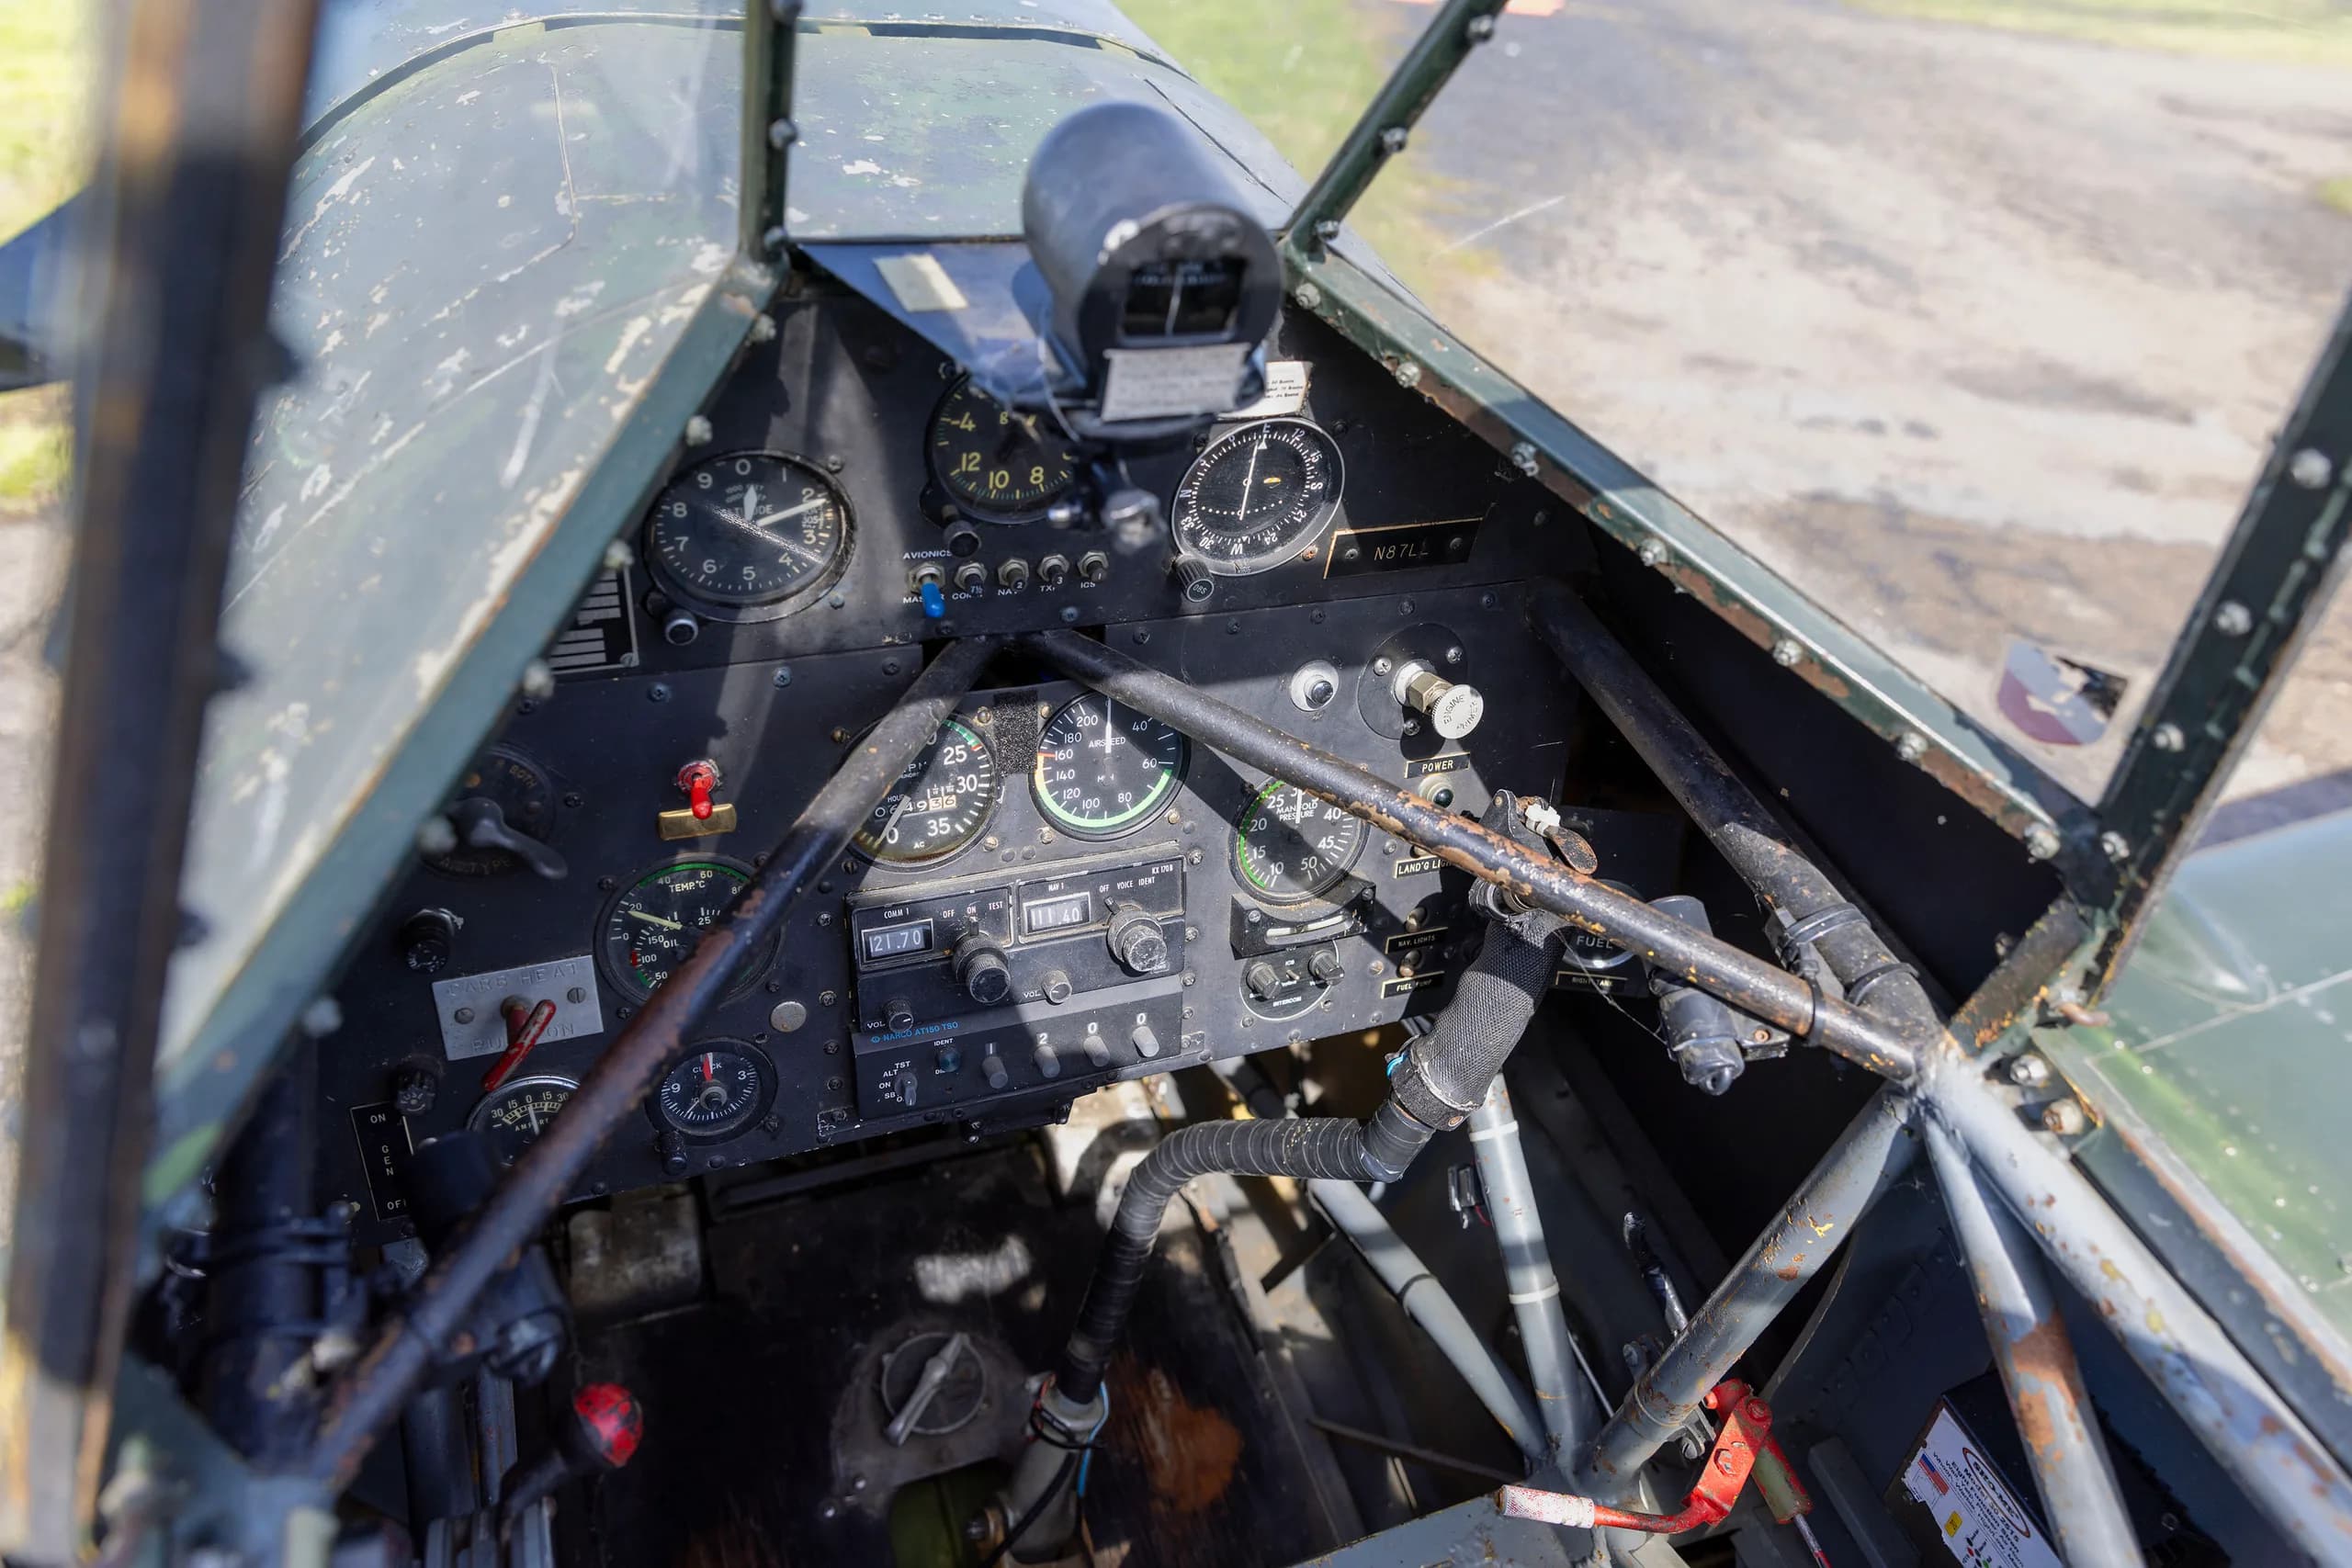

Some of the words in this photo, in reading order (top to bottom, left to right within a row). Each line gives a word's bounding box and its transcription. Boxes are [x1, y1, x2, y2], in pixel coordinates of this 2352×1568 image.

[1262, 423, 1271, 434] E
[1293, 428, 1305, 438] 12
[962, 452, 981, 471] 12
[1310, 450, 1322, 463] 15
[735, 459, 752, 476] 0
[696, 472, 713, 489] 9
[989, 470, 1010, 490] 10
[1030, 467, 1044, 484] 8
[1310, 482, 1323, 491] S
[801, 488, 814, 502] 2
[1180, 489, 1193, 498] N
[673, 502, 687, 517] 8
[1181, 516, 1194, 531] 33
[803, 529, 816, 545] 3
[1199, 536, 1214, 549] 30
[674, 536, 689, 551] 7
[1230, 544, 1243, 555] W
[779, 553, 793, 566] 4
[703, 559, 717, 574] 6
[742, 566, 756, 581] 5
[1057, 576, 1063, 584] 3
[1193, 583, 1207, 594] OBS
[1443, 694, 1464, 724] ENGINE
[1077, 715, 1098, 727] 200
[1132, 720, 1148, 731] 40
[1065, 732, 1082, 743] 180
[943, 745, 967, 765] 25
[1055, 749, 1073, 761] 160
[1142, 758, 1158, 769] 60
[1422, 760, 1453, 773] POWER
[1057, 770, 1075, 781] 140
[956, 774, 978, 794] 30
[1063, 788, 1080, 799] 120
[1118, 792, 1132, 803] 80
[1082, 798, 1100, 808] 100
[1267, 795, 1284, 808] 25
[1323, 807, 1341, 820] 40
[927, 818, 950, 836] 35
[1250, 818, 1267, 831] 20
[886, 828, 899, 844] 0
[1317, 836, 1334, 850] 45
[1253, 845, 1266, 859] 15
[1270, 862, 1284, 874] 10
[1301, 856, 1317, 870] 50
[1398, 862, 1429, 874] LAND'G
[658, 876, 671, 885] 40
[700, 871, 713, 879] 60
[1100, 884, 1110, 893] OFF
[1117, 881, 1134, 889] VOICE
[1138, 877, 1155, 886] IDENT
[629, 902, 642, 911] 20
[943, 909, 955, 918] OFF
[967, 906, 977, 914] ON
[989, 901, 1003, 910] TEST
[884, 910, 903, 919] COMM
[698, 917, 711, 925] 25
[623, 932, 629, 942] 0
[648, 934, 664, 944] 150
[869, 931, 922, 953] 121.70
[1576, 935, 1613, 949] FUEL
[663, 939, 679, 948] OIL
[641, 954, 657, 964] 100
[521, 964, 577, 985] HEAT
[655, 971, 668, 980] 50
[1396, 983, 1412, 992] FUEL
[883, 1030, 911, 1041] NARCO
[915, 1026, 940, 1035] AT150
[1039, 1032, 1047, 1044] 2
[1088, 1022, 1098, 1033] 0
[1136, 1013, 1146, 1024] 0
[934, 1038, 954, 1046] IDENT
[895, 1061, 910, 1069] TST
[738, 1070, 747, 1080] 3
[883, 1069, 899, 1077] ALT
[671, 1083, 681, 1093] 9
[526, 1094, 533, 1103] 0
[542, 1091, 552, 1101] 15
[557, 1092, 569, 1102] 30
[508, 1099, 519, 1109] 15
[370, 1113, 386, 1123] ON
[491, 1108, 504, 1119] 30
[381, 1145, 394, 1176] GEN
[1964, 1468, 1987, 1501] Model
[1951, 1461, 1969, 1485] Eight
[1970, 1486, 1999, 1527] Function
[2000, 1528, 2018, 1552] Siren
